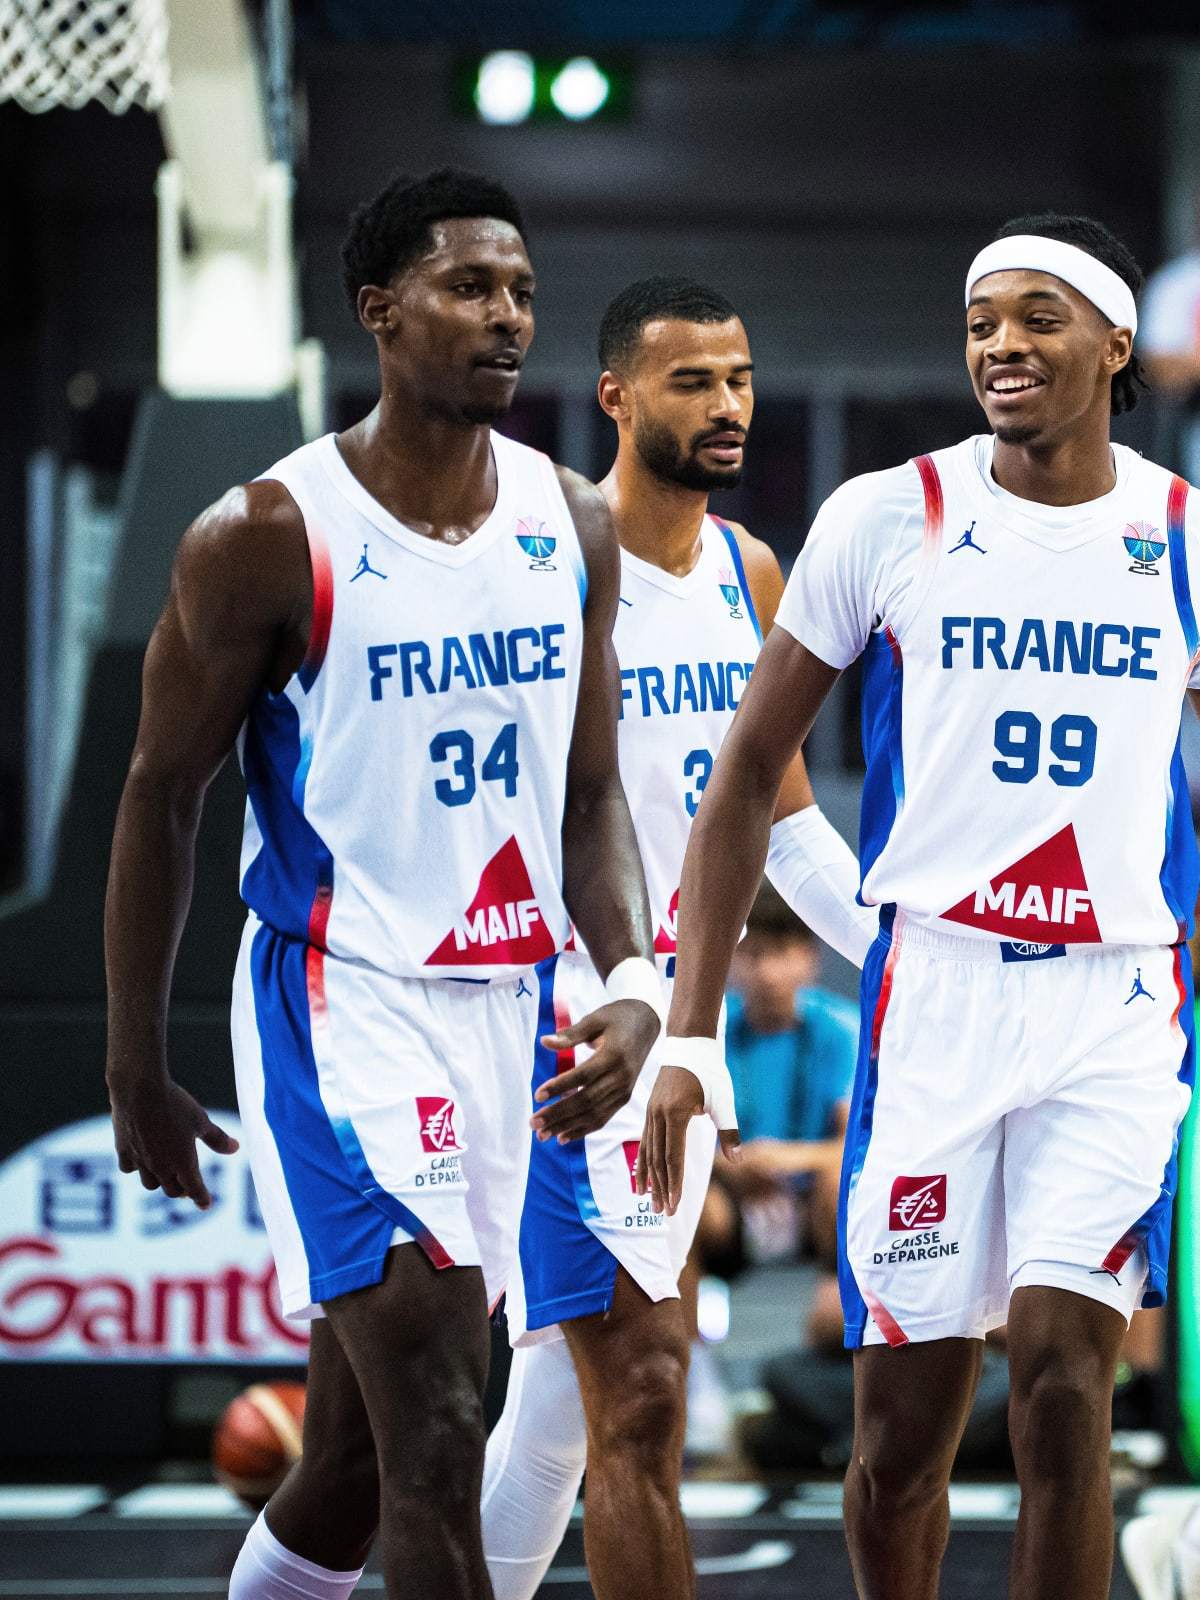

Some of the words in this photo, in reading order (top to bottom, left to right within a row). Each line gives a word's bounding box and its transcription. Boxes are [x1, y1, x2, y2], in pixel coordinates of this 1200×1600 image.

[367, 623, 567, 701] FRANCE
[942, 616, 1161, 681] FRANCE
[618, 661, 756, 721] FRANC
[429, 722, 520, 808] 34
[992, 710, 1098, 787] 99
[453, 898, 541, 952] MAIF
[973, 881, 1092, 926] MAIF
[873, 1241, 960, 1265] D'EPARGNE
[891, 1231, 941, 1251] CAISSE
